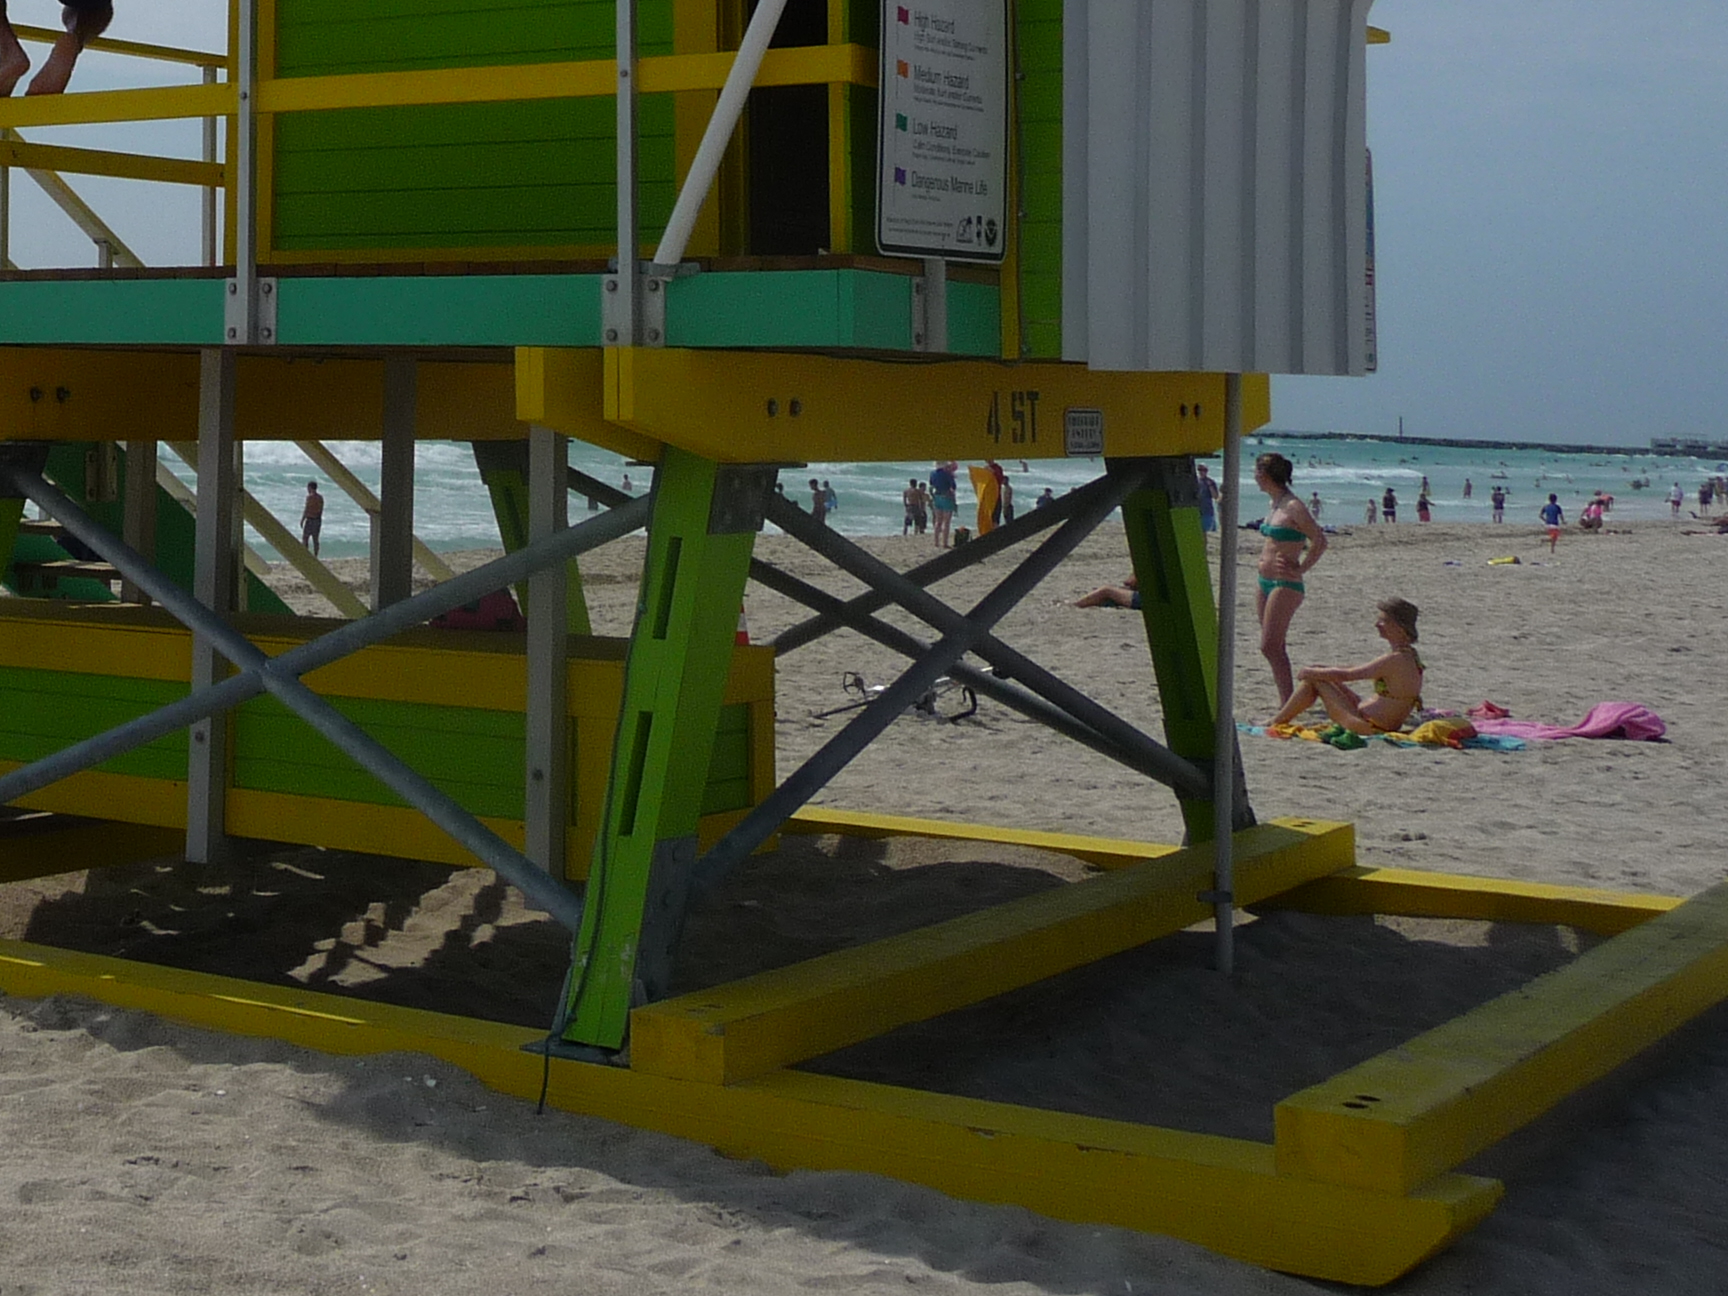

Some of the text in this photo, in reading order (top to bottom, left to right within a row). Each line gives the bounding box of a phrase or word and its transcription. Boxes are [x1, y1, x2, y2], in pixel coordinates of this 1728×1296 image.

[914, 10, 955, 35] High Hazard
[913, 64, 970, 90] Medium Hazard
[912, 117, 958, 141] Low Hazard
[911, 170, 989, 196] Dangerous Marine Life
[986, 390, 1040, 444] 4 ST
